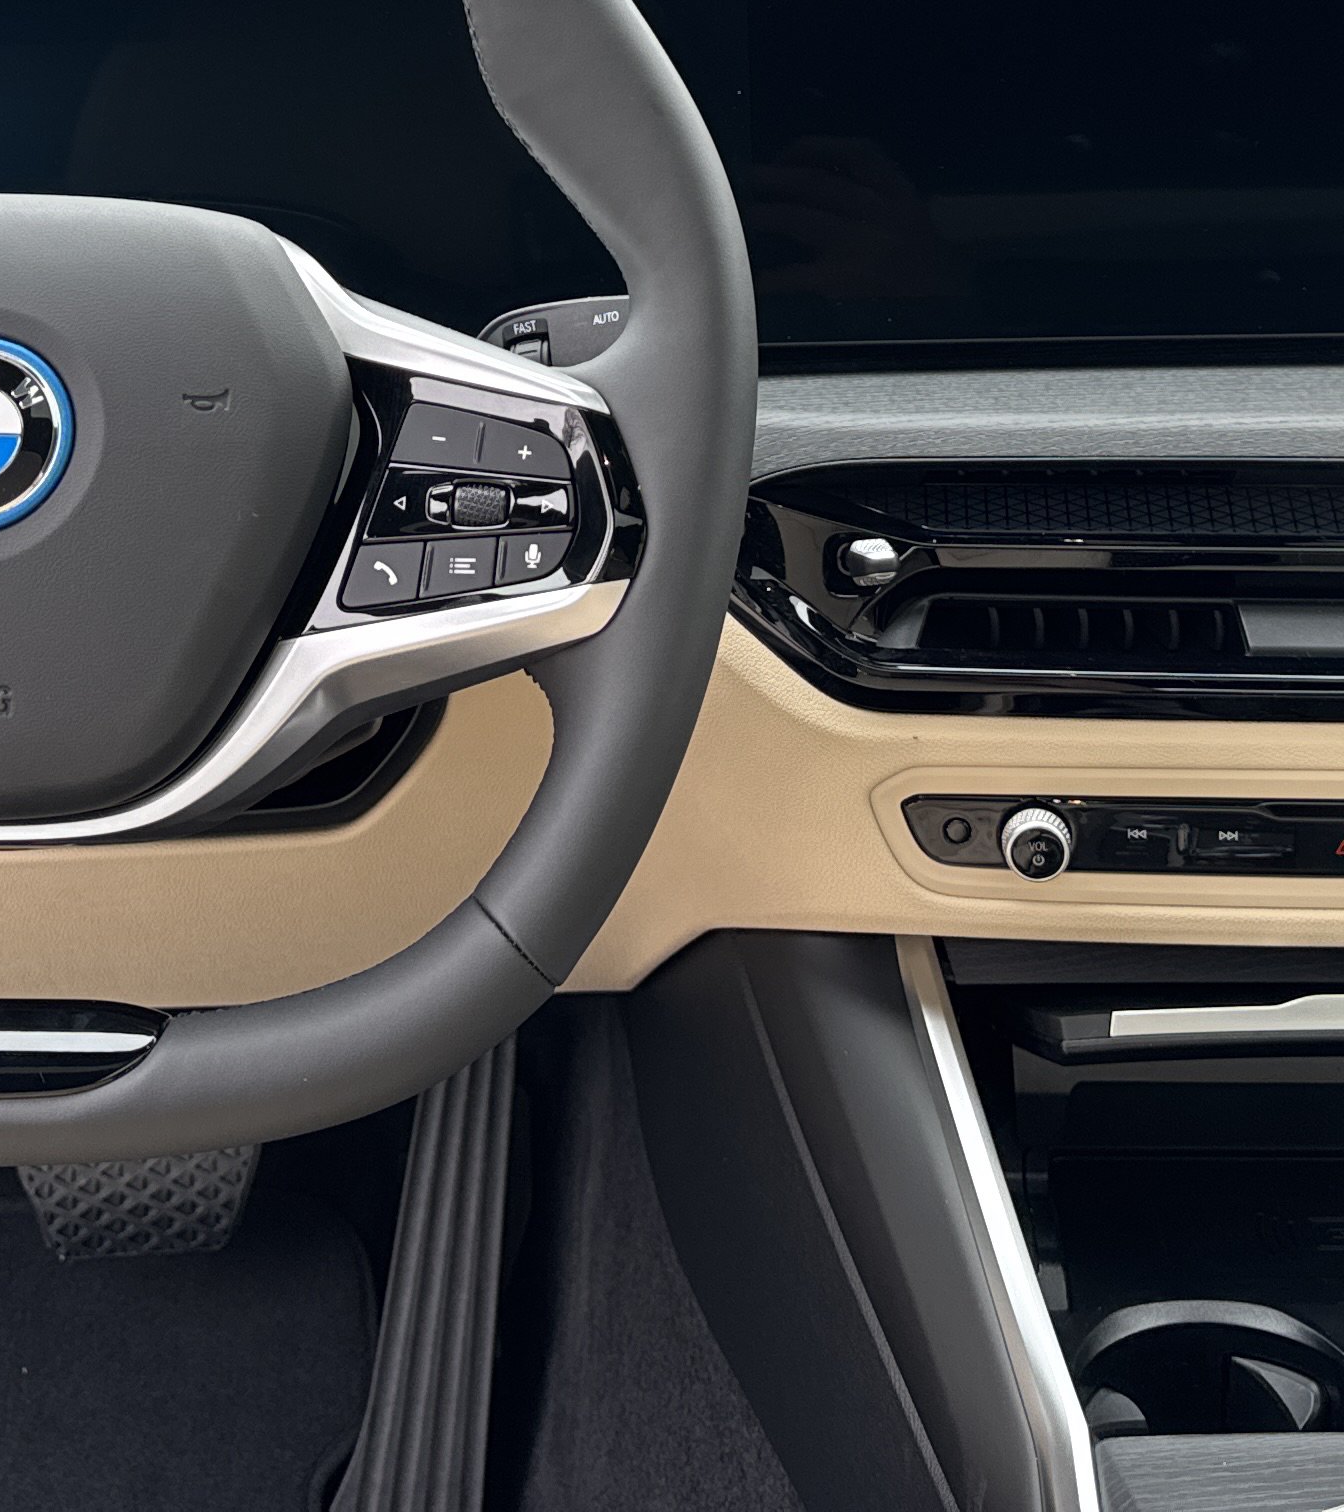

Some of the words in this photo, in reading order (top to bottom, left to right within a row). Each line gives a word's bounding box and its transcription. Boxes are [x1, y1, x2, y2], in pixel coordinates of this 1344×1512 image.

[593, 310, 620, 326] AUTO
[513, 320, 537, 335] FAST
[1027, 841, 1049, 852] VOL
